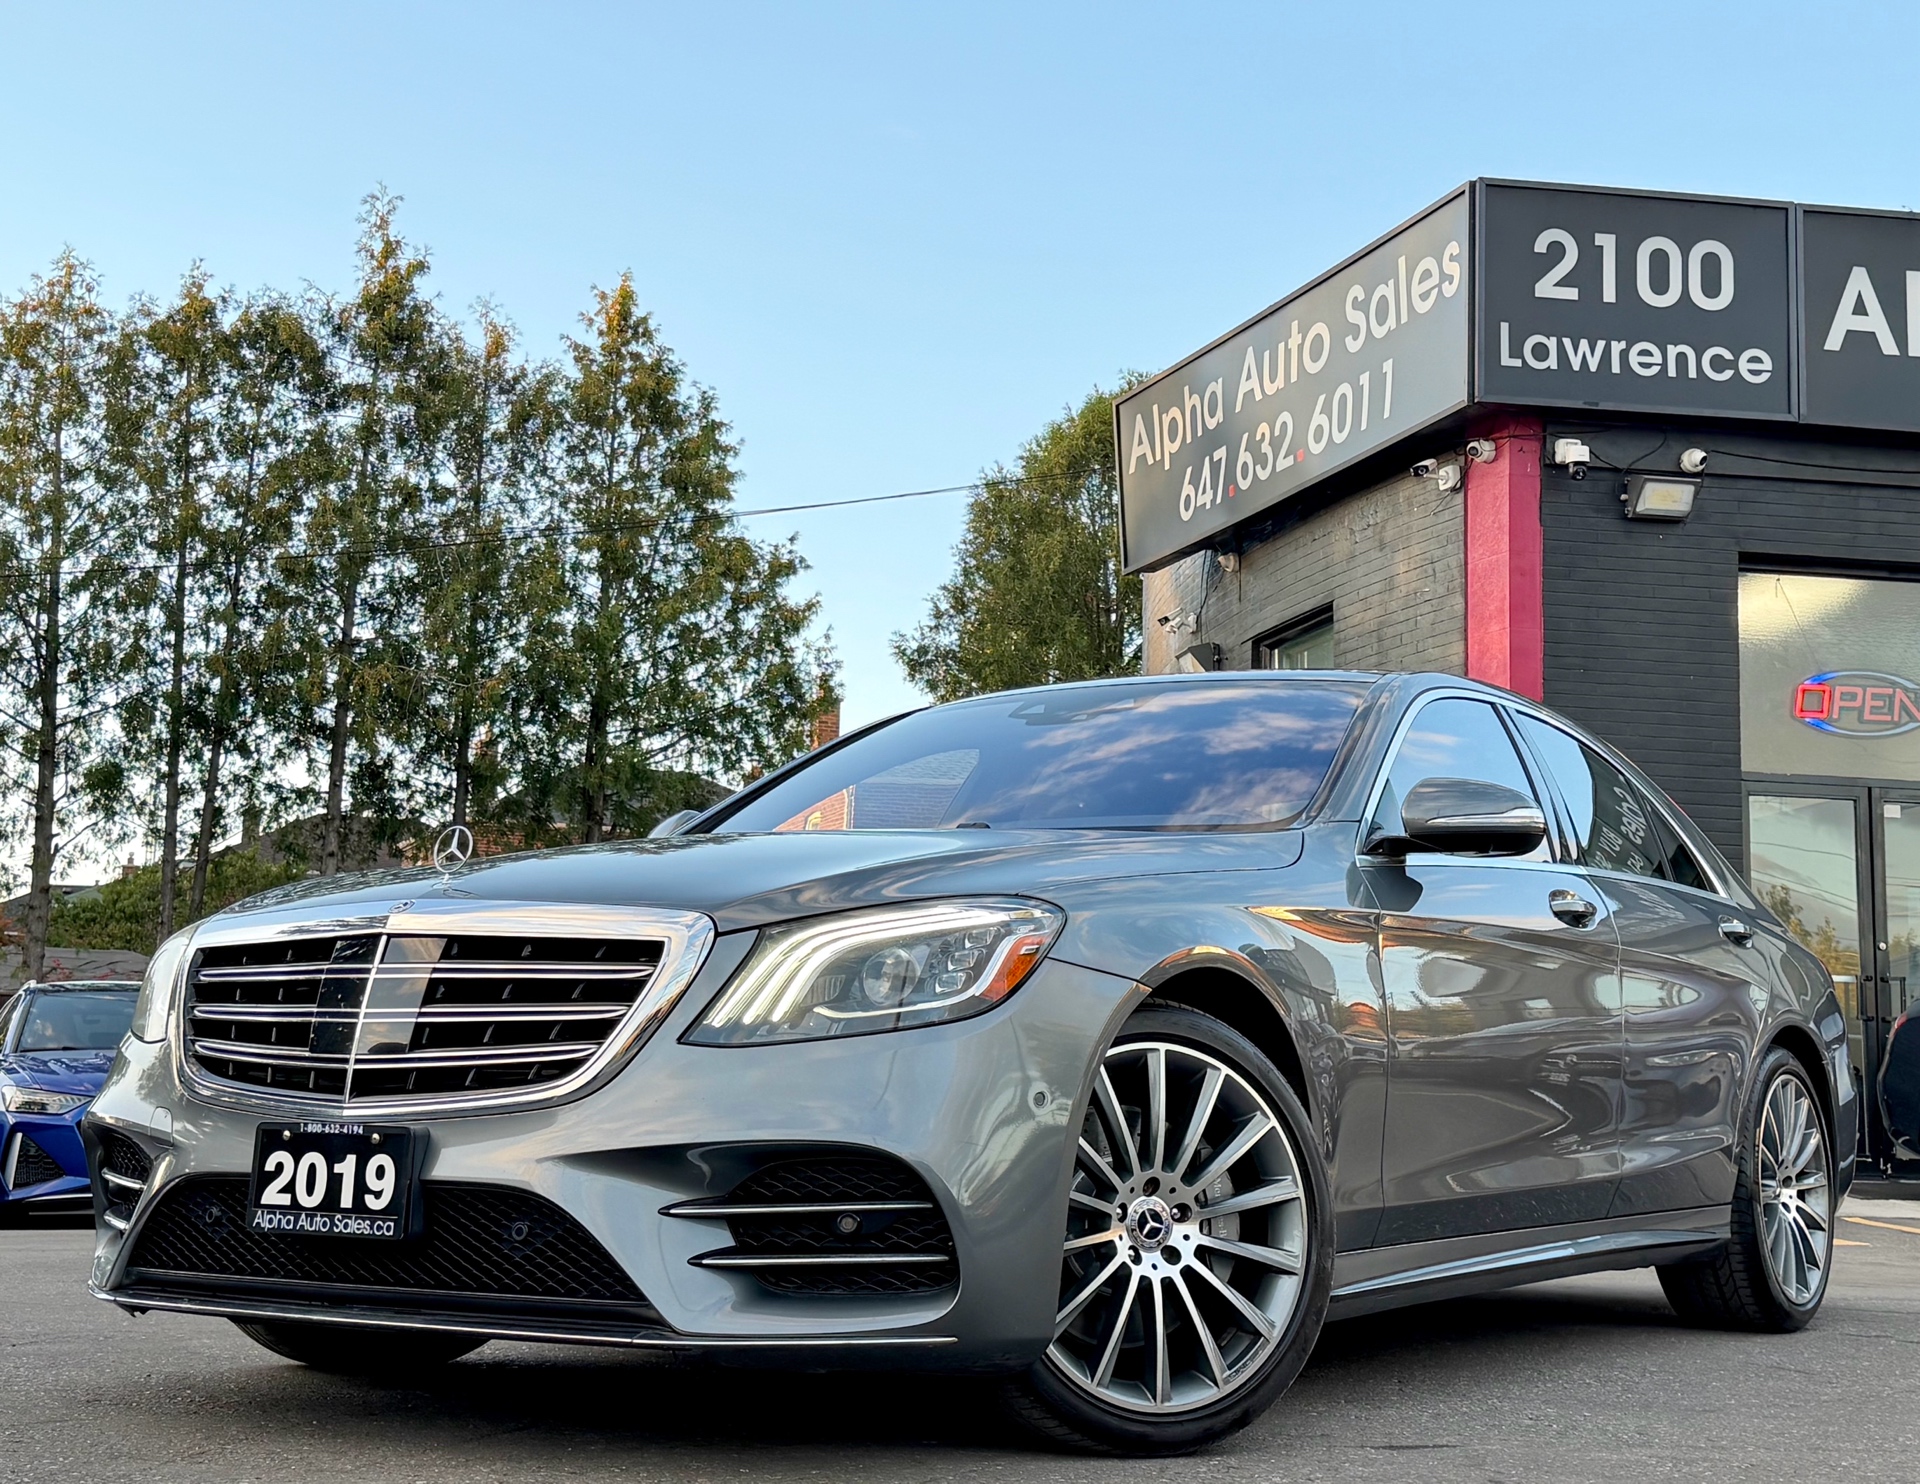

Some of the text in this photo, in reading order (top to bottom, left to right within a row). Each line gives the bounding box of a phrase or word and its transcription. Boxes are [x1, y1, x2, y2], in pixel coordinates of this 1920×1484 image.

[1533, 227, 1735, 311] 2100
[1128, 240, 1461, 475] Alpha Auto Sales
[1499, 321, 1774, 385] Lawrence
[1178, 357, 1395, 523] 647.632.6011
[1794, 683, 1920, 722] OPEN
[260, 1150, 396, 1211] 2019
[252, 1210, 395, 1236] Alpha Auto Sales.ca
